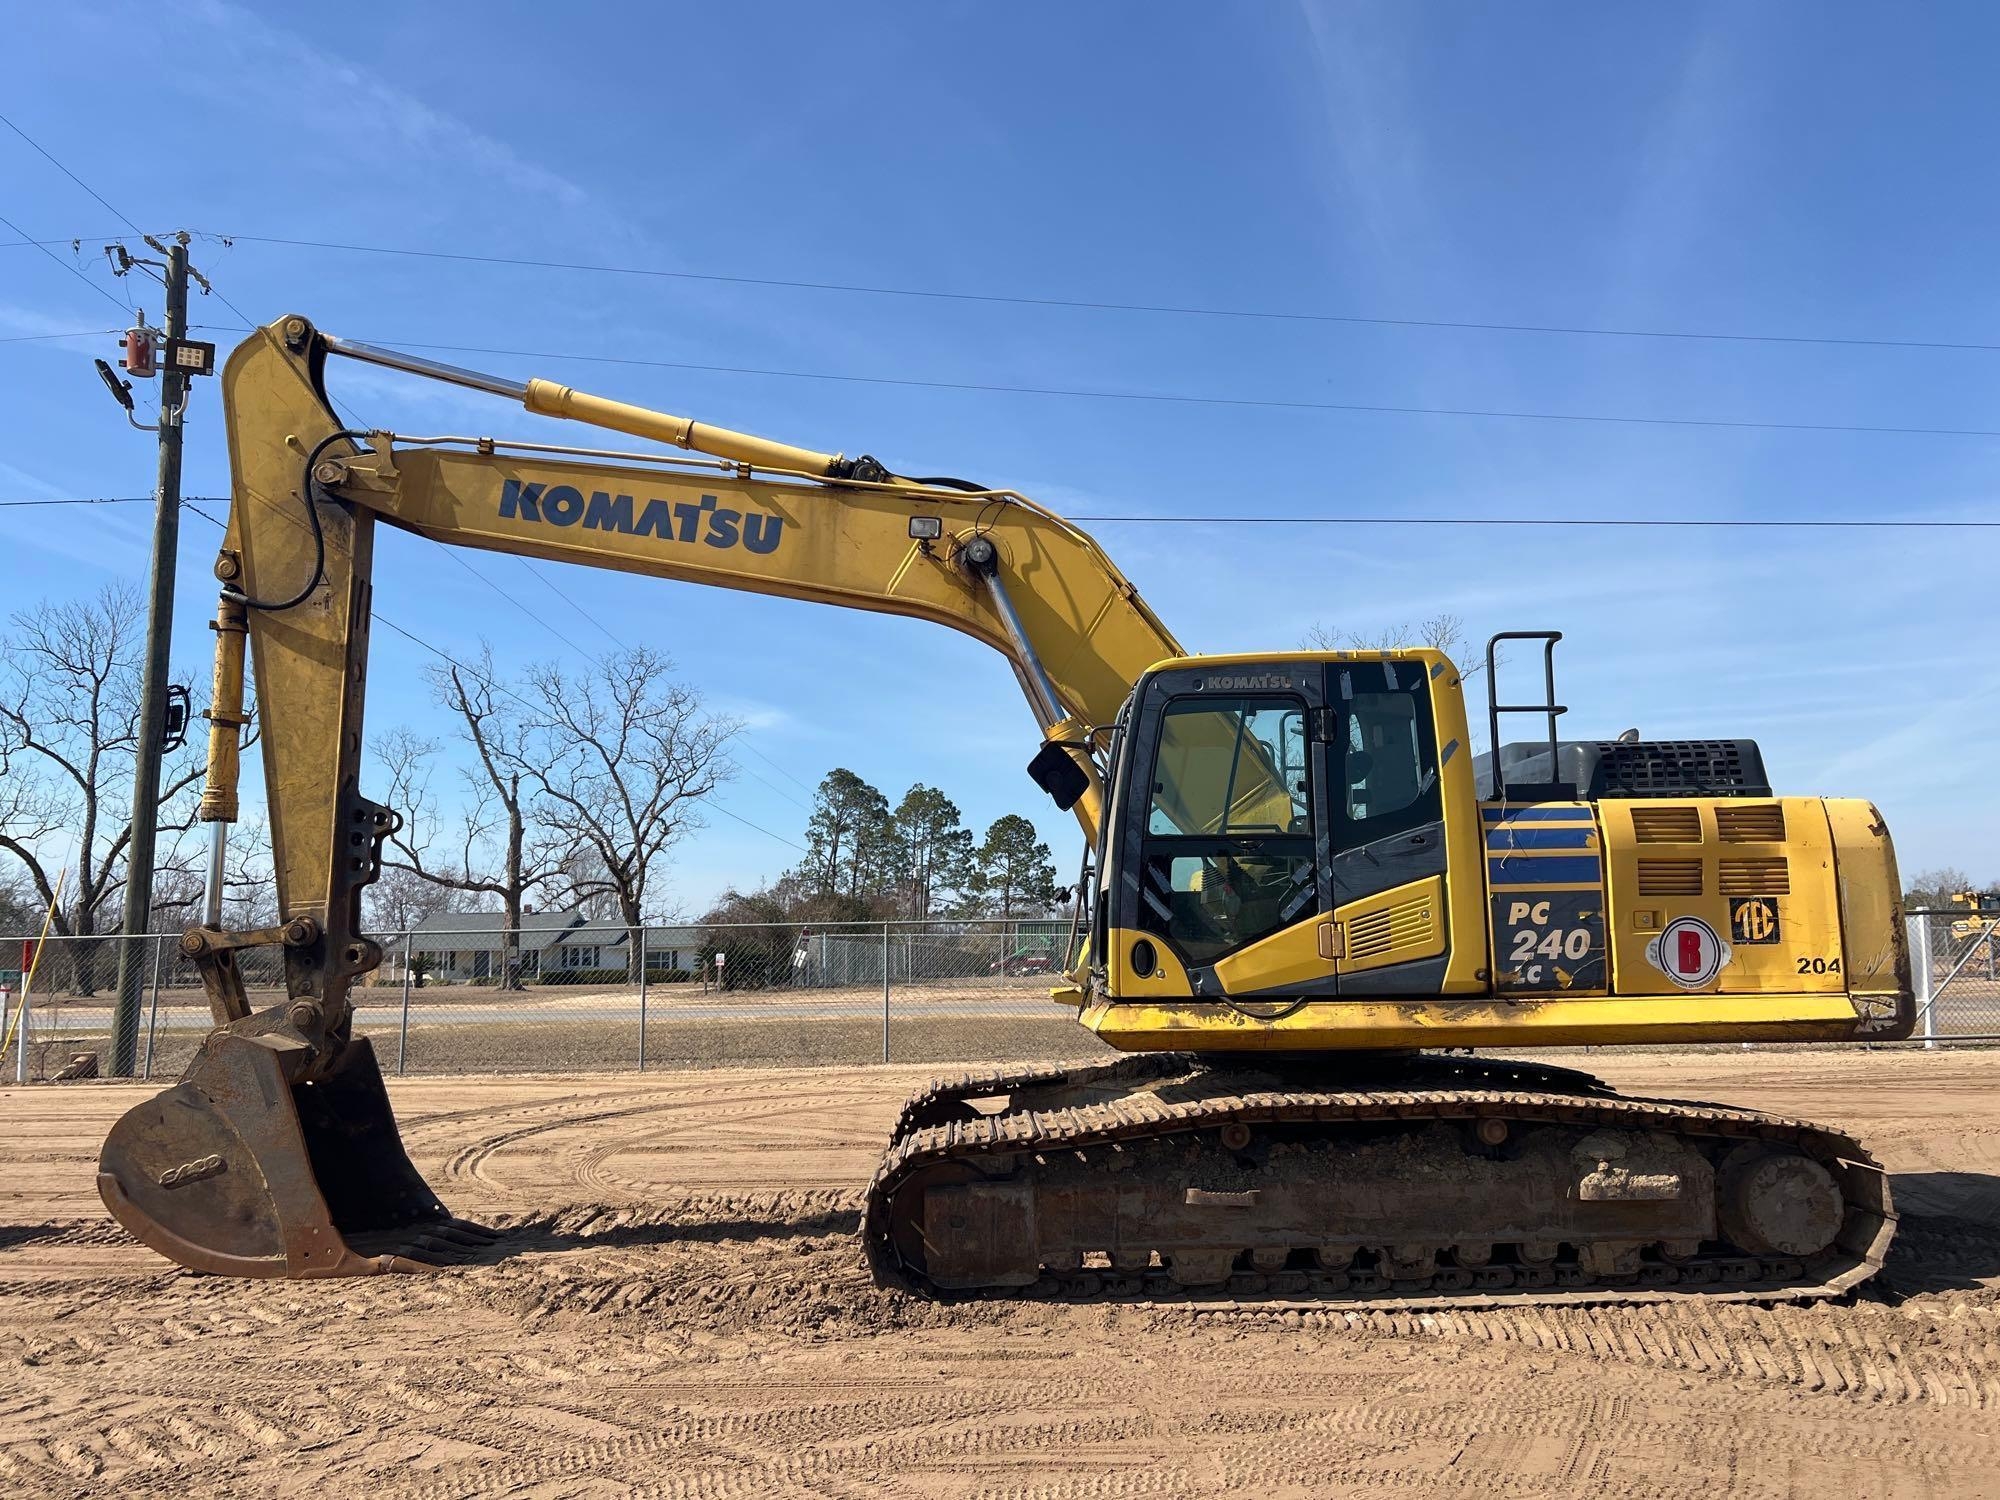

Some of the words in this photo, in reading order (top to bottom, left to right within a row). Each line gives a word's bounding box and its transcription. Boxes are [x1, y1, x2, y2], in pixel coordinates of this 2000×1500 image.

[498, 479, 783, 554] KOMATSU
[1208, 673, 1292, 689] KOMATSU
[1508, 901, 1551, 925] PC
[1735, 901, 1774, 940] TEC
[1509, 928, 1591, 960] 240
[1678, 931, 1701, 973] B
[1797, 957, 1840, 975] 204
